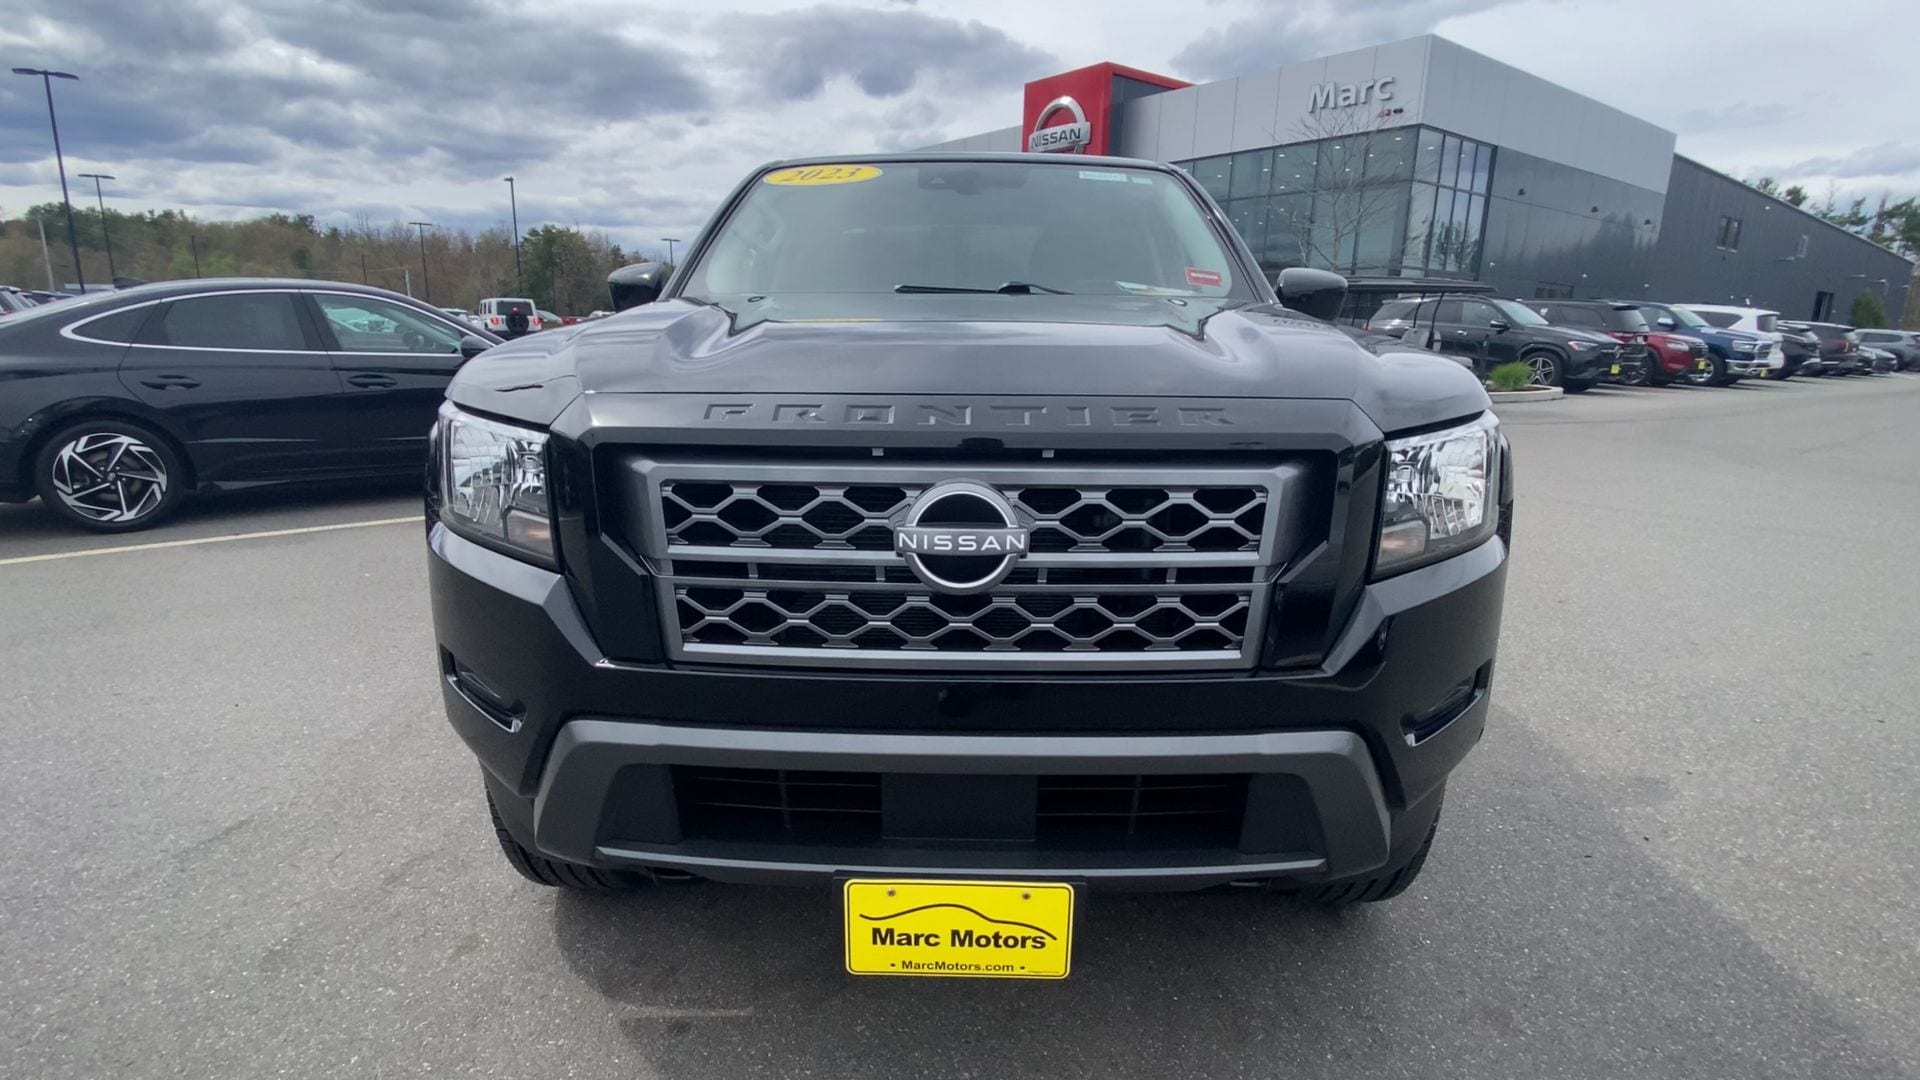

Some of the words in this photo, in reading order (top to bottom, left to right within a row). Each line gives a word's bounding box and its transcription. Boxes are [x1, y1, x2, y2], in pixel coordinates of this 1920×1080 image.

[1308, 77, 1395, 113] Marc
[1031, 127, 1081, 149] NISSAN
[778, 167, 862, 182] 2023
[704, 402, 1236, 427] FRONTIER
[899, 532, 1025, 551] NISSAN
[871, 927, 941, 947] Marc
[950, 929, 1046, 949] Motors
[901, 960, 1015, 972] MarcMotors.com
